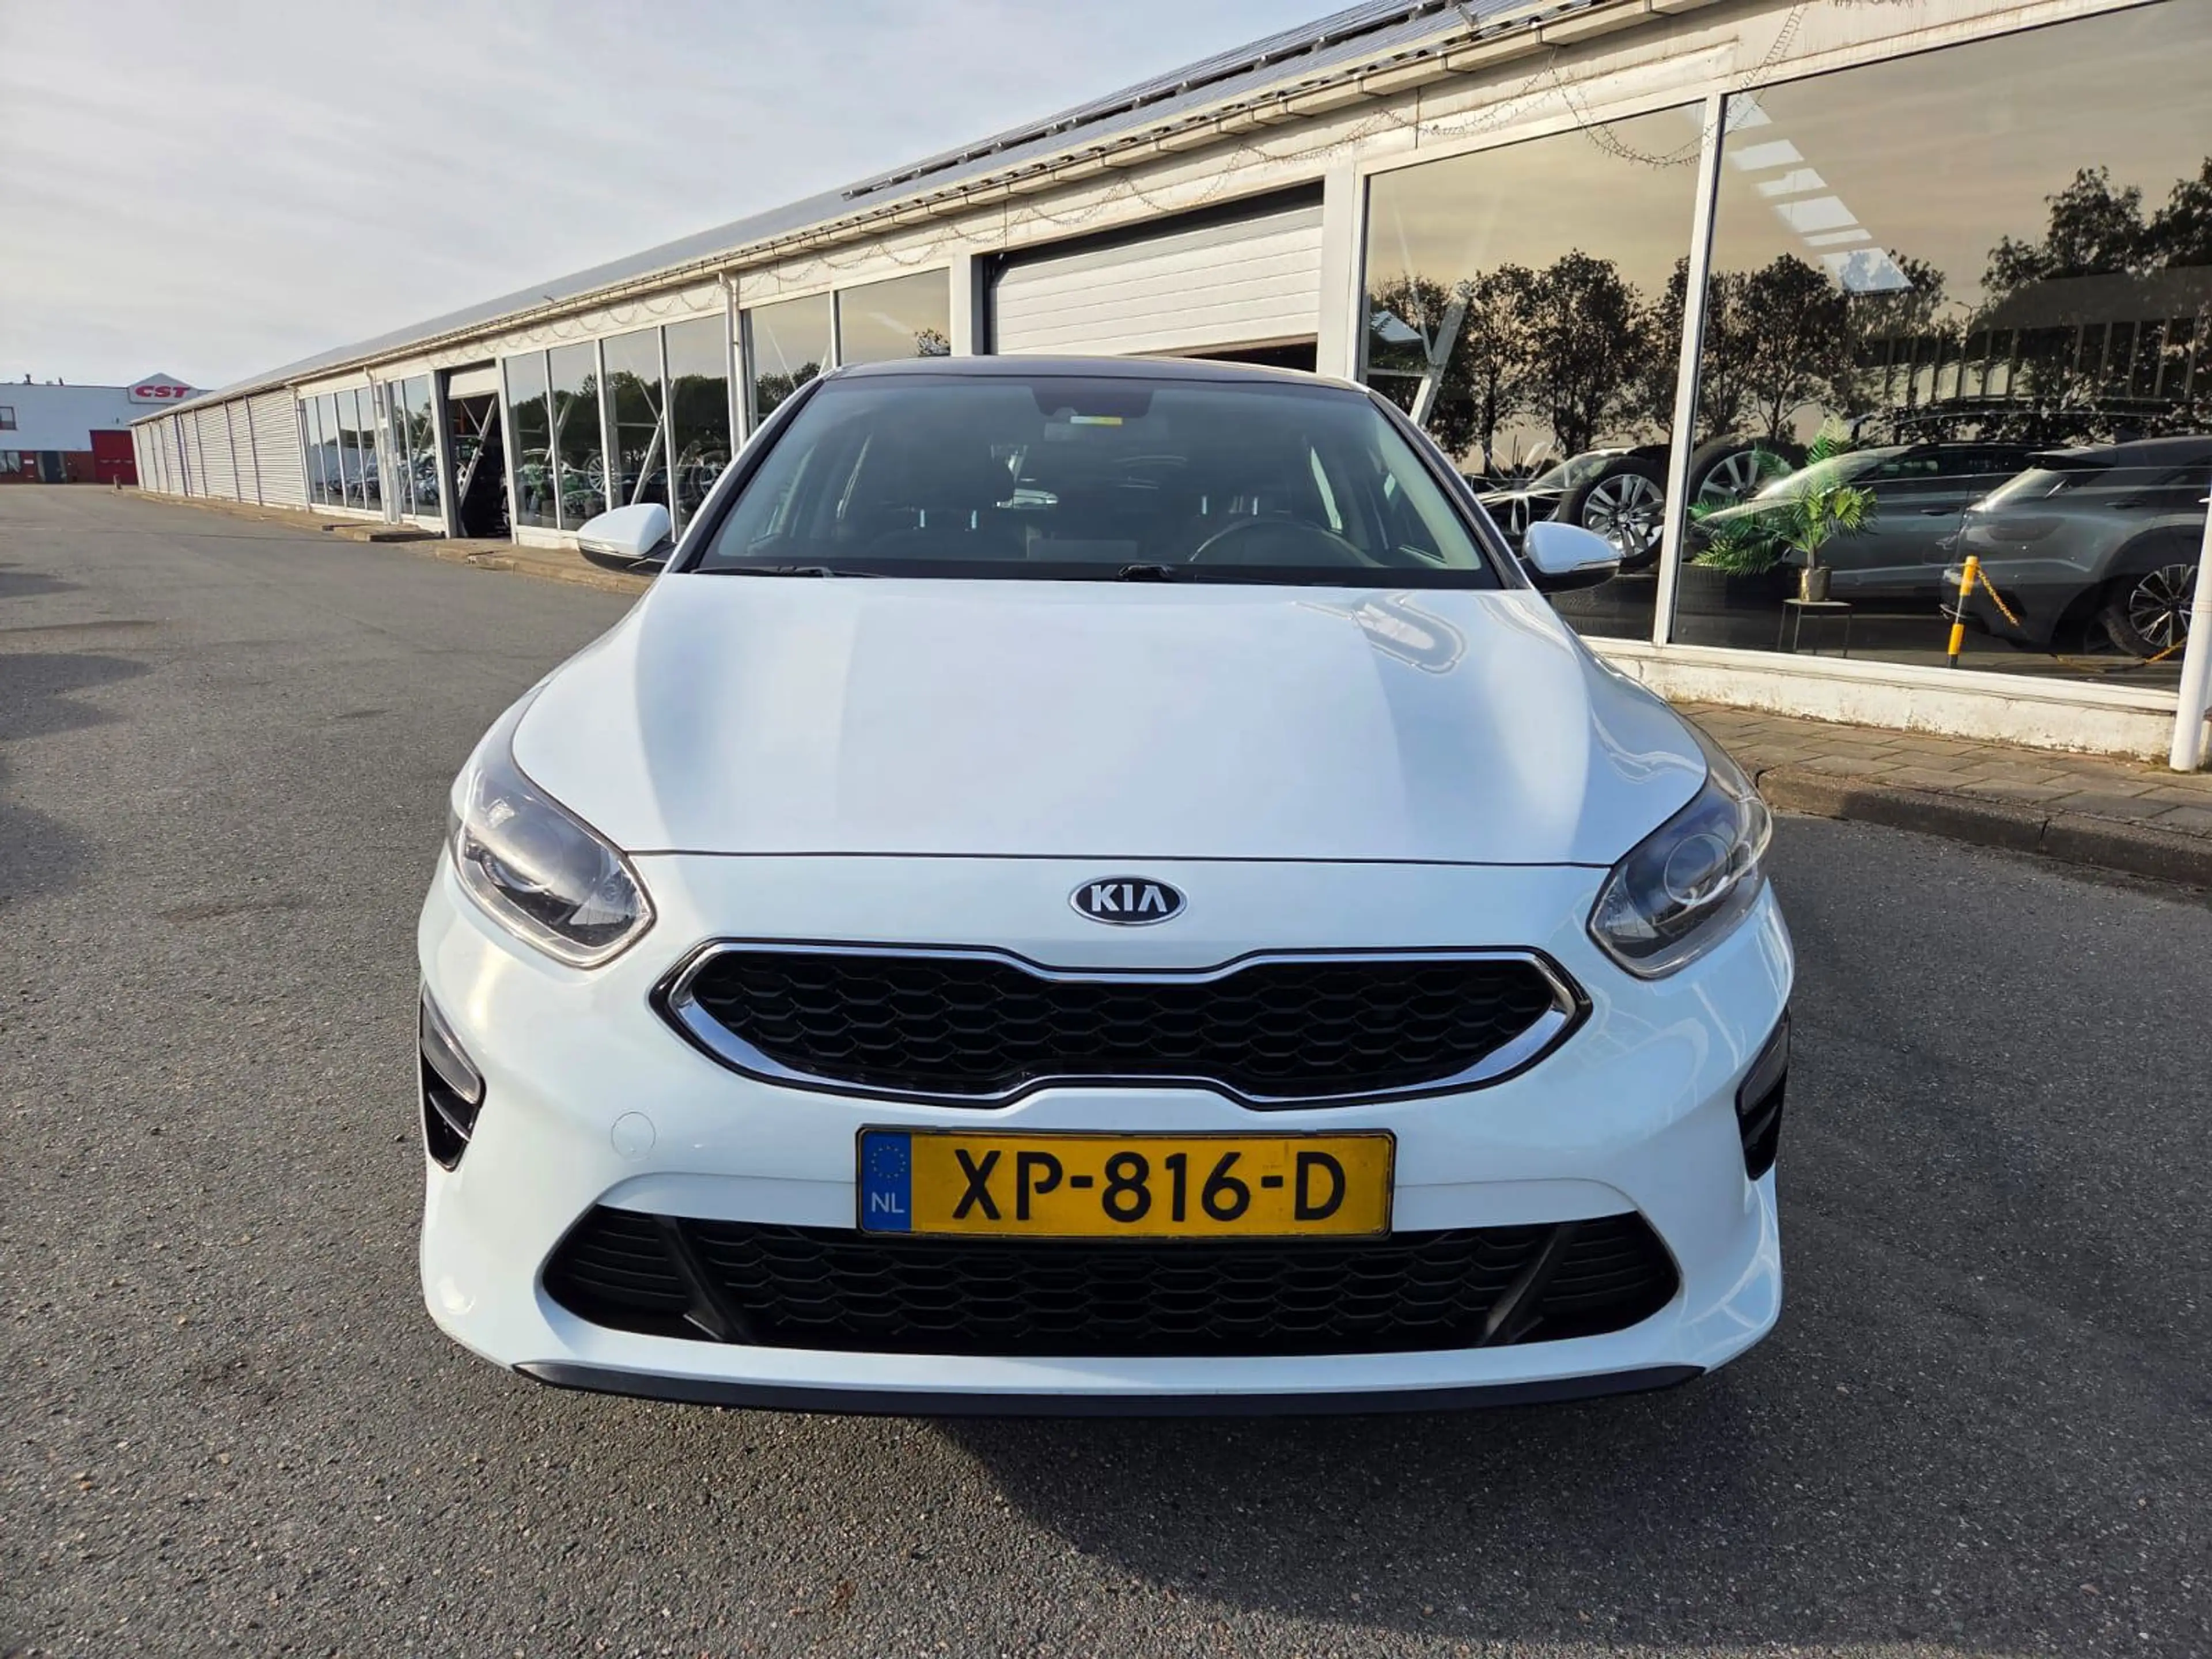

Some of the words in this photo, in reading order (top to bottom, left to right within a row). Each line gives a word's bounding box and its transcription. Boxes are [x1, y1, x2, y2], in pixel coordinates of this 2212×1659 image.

[135, 385, 191, 398] CST
[1090, 884, 1168, 912] KIA
[952, 1149, 1347, 1222] XP-816-D
[871, 1191, 906, 1213] NL
